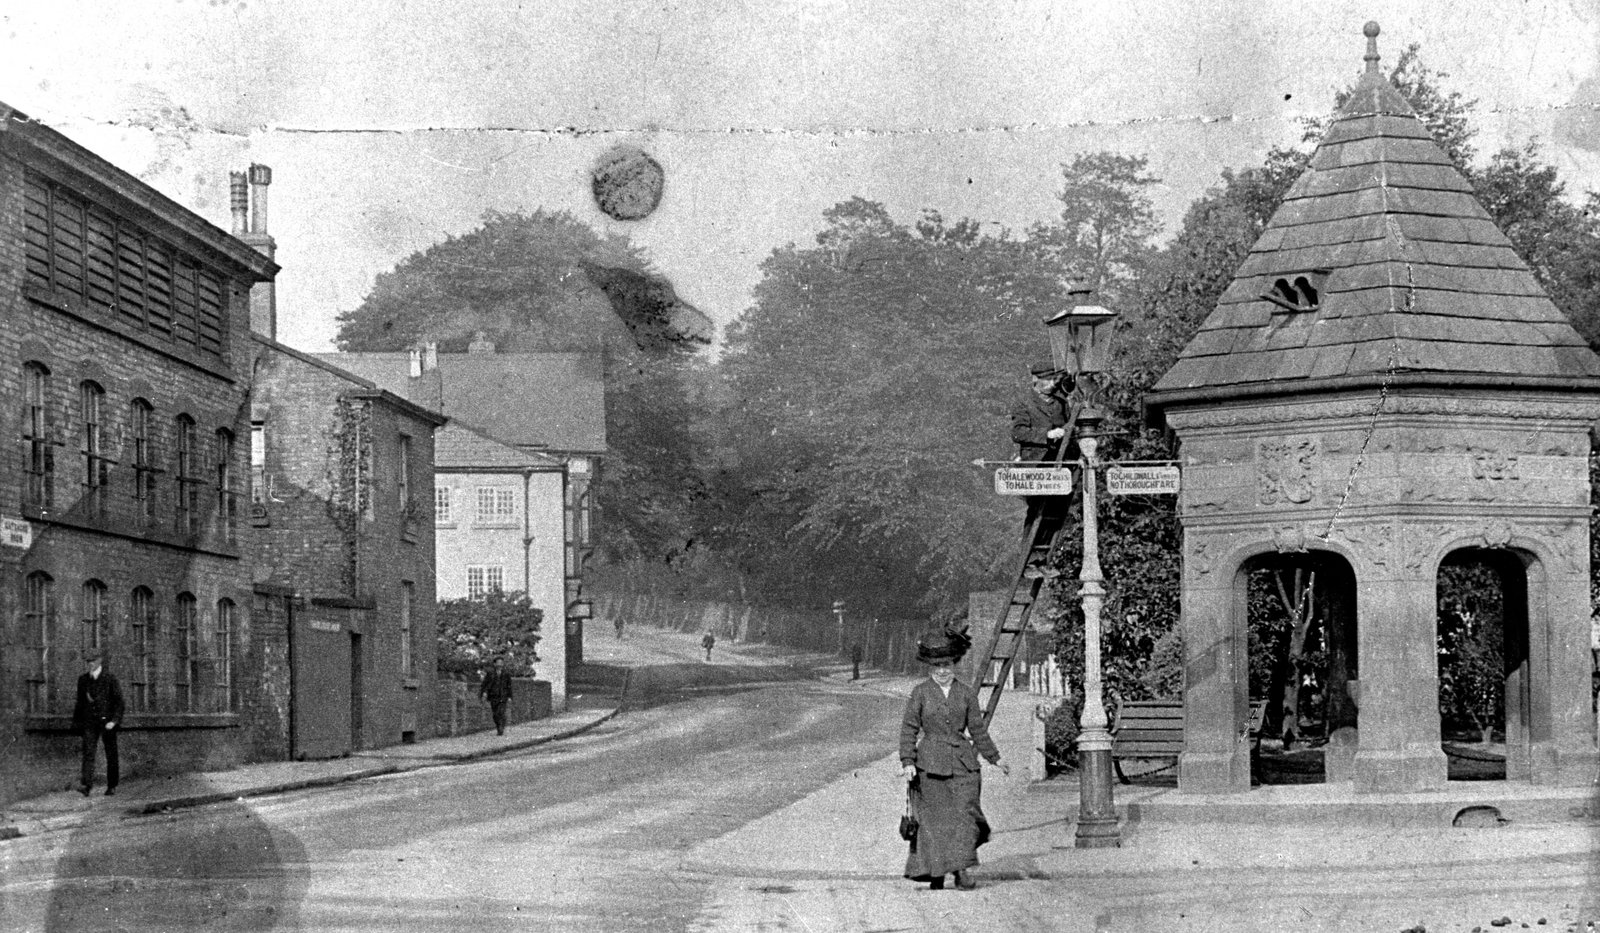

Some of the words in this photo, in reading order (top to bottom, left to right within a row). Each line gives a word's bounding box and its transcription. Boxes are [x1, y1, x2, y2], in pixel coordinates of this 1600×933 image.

[1008, 472, 1045, 481] HALEWOOD
[1046, 472, 1052, 481] 2
[1015, 481, 1034, 490] HALE
[1120, 480, 1176, 489] THOROUGHFARE
